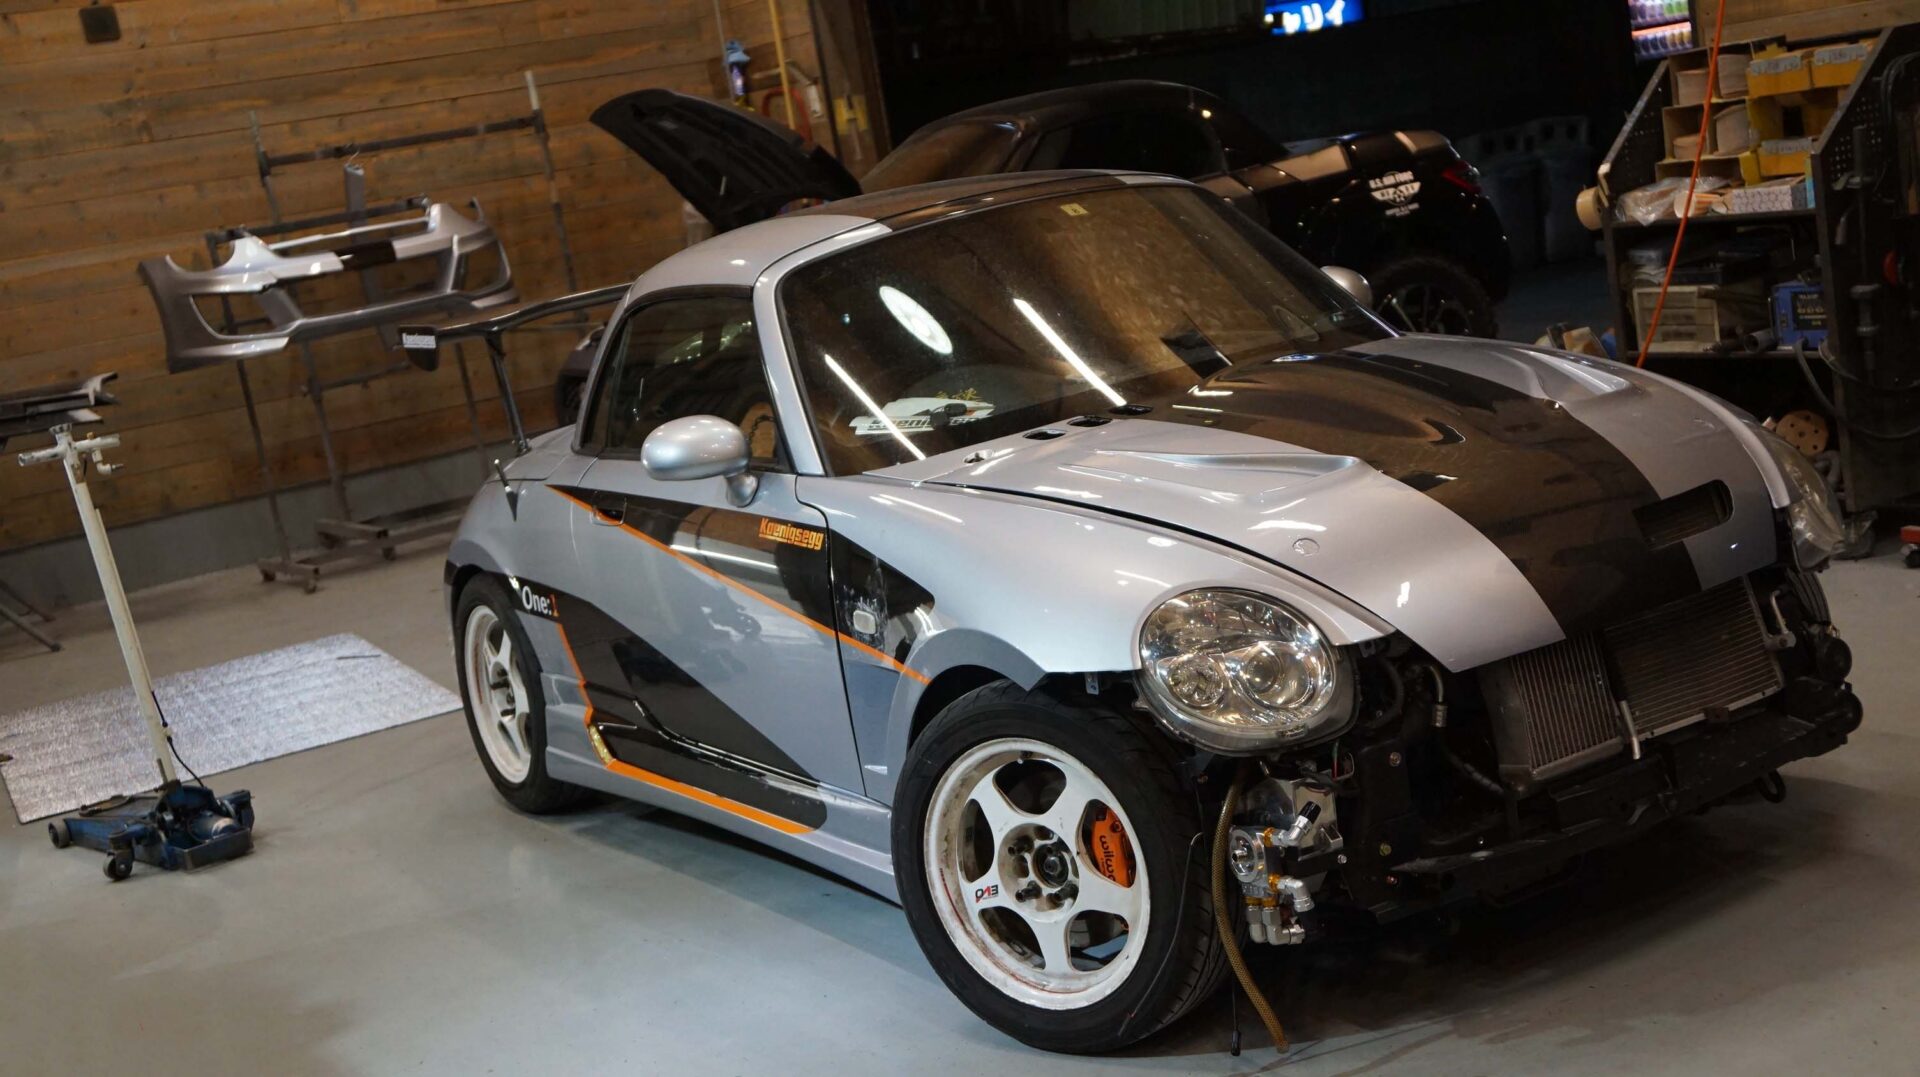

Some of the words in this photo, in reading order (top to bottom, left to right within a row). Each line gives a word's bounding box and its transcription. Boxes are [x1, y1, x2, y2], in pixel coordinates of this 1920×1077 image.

[759, 517, 824, 550] Koenigsegg
[522, 585, 559, 617] One:1
[1099, 835, 1116, 882] wilwo
